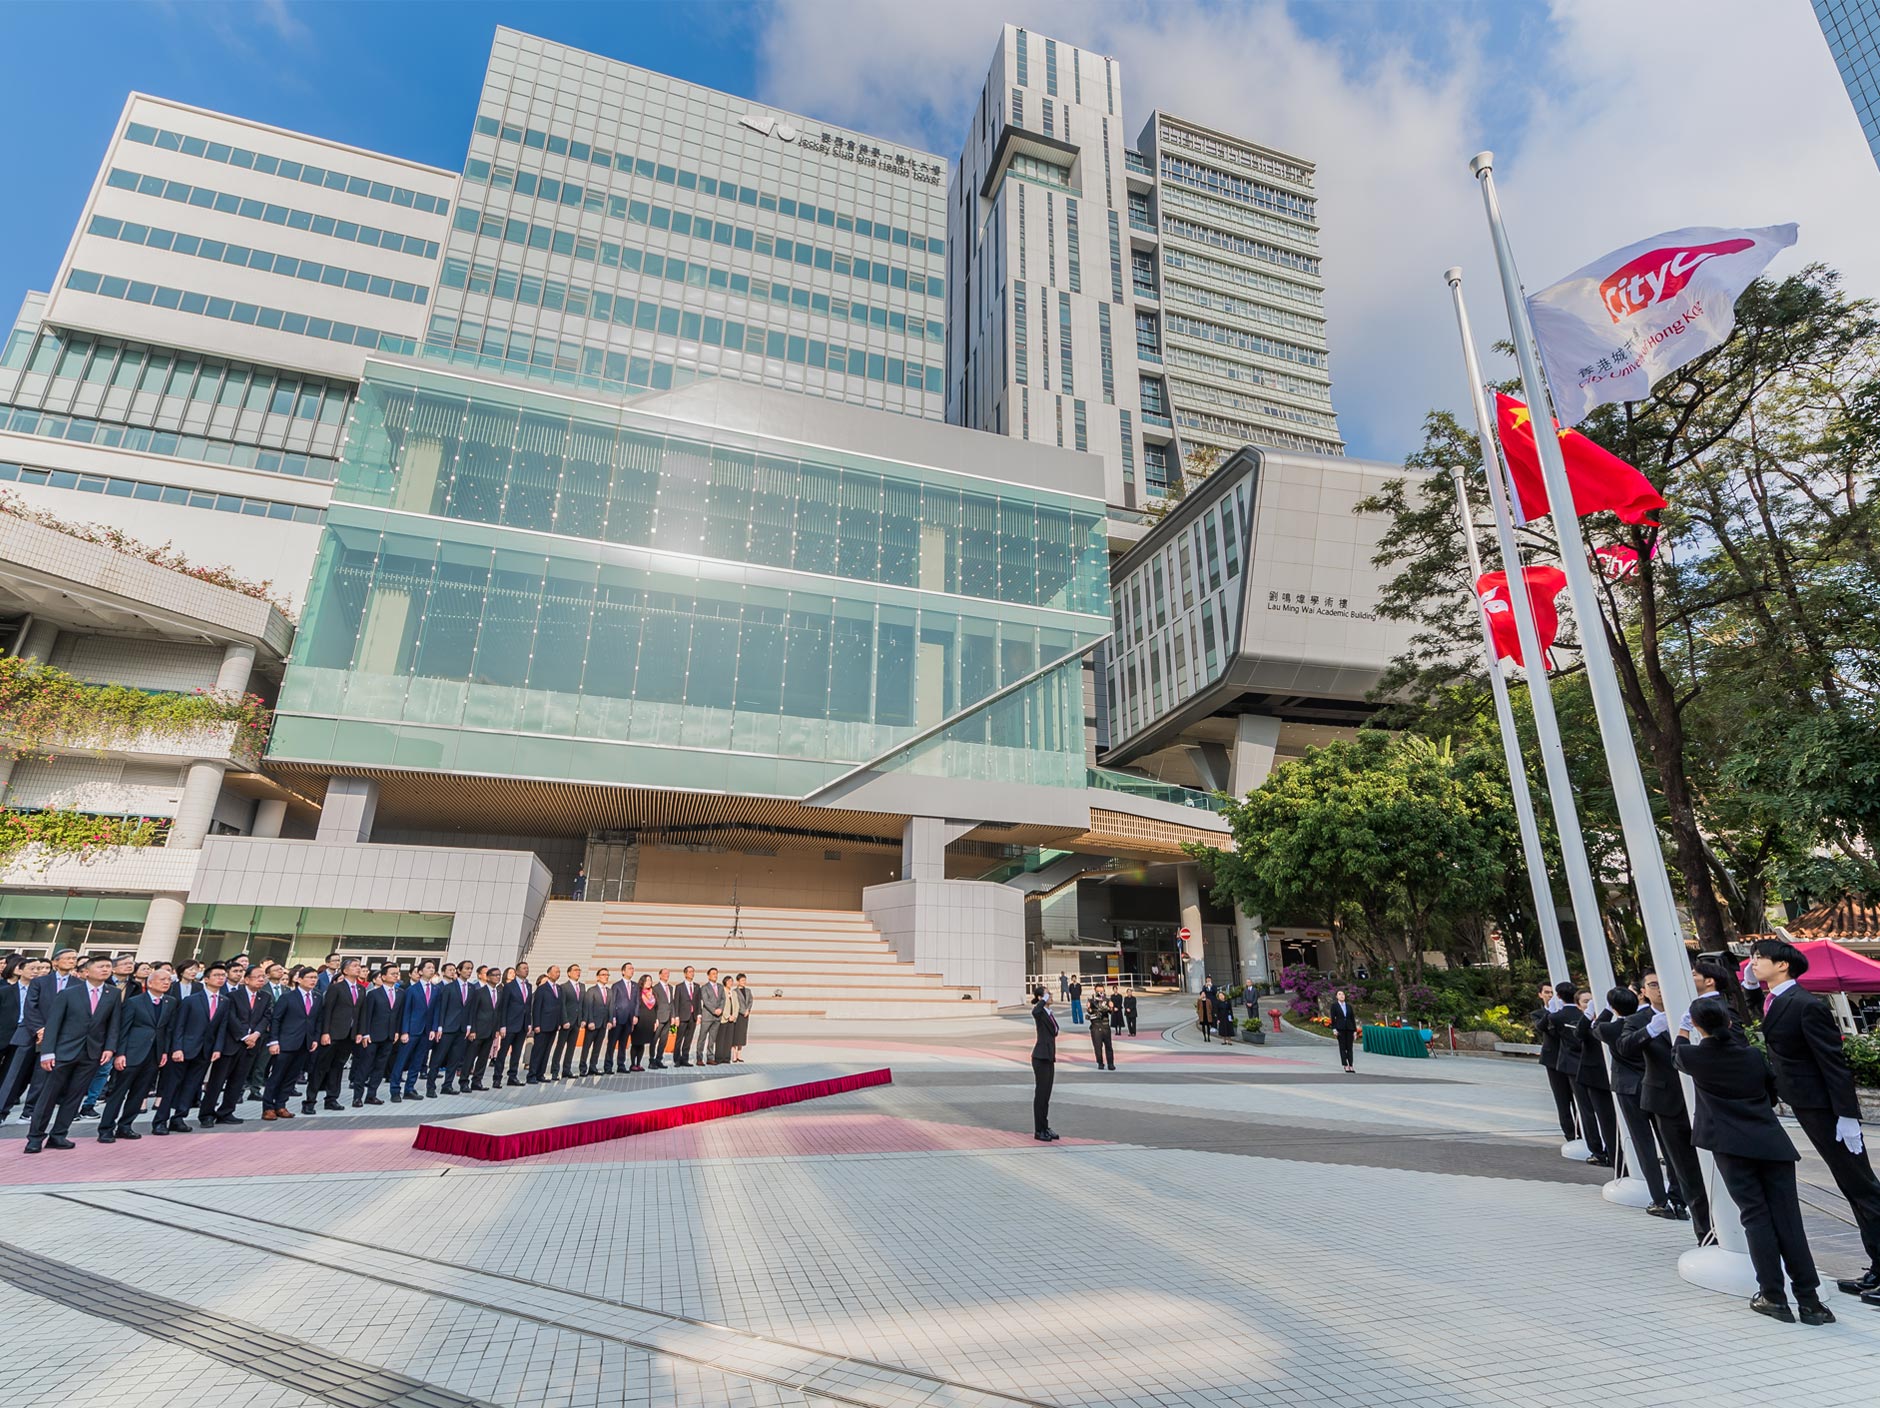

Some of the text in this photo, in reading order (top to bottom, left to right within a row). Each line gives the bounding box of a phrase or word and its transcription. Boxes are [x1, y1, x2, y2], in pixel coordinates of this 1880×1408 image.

[798, 136, 831, 157] Jockey
[879, 160, 910, 178] Health
[1605, 251, 1717, 320] CityU
[1647, 319, 1687, 349] Hong
[1267, 602, 1377, 622] Lau Ming Wai Academic Building
